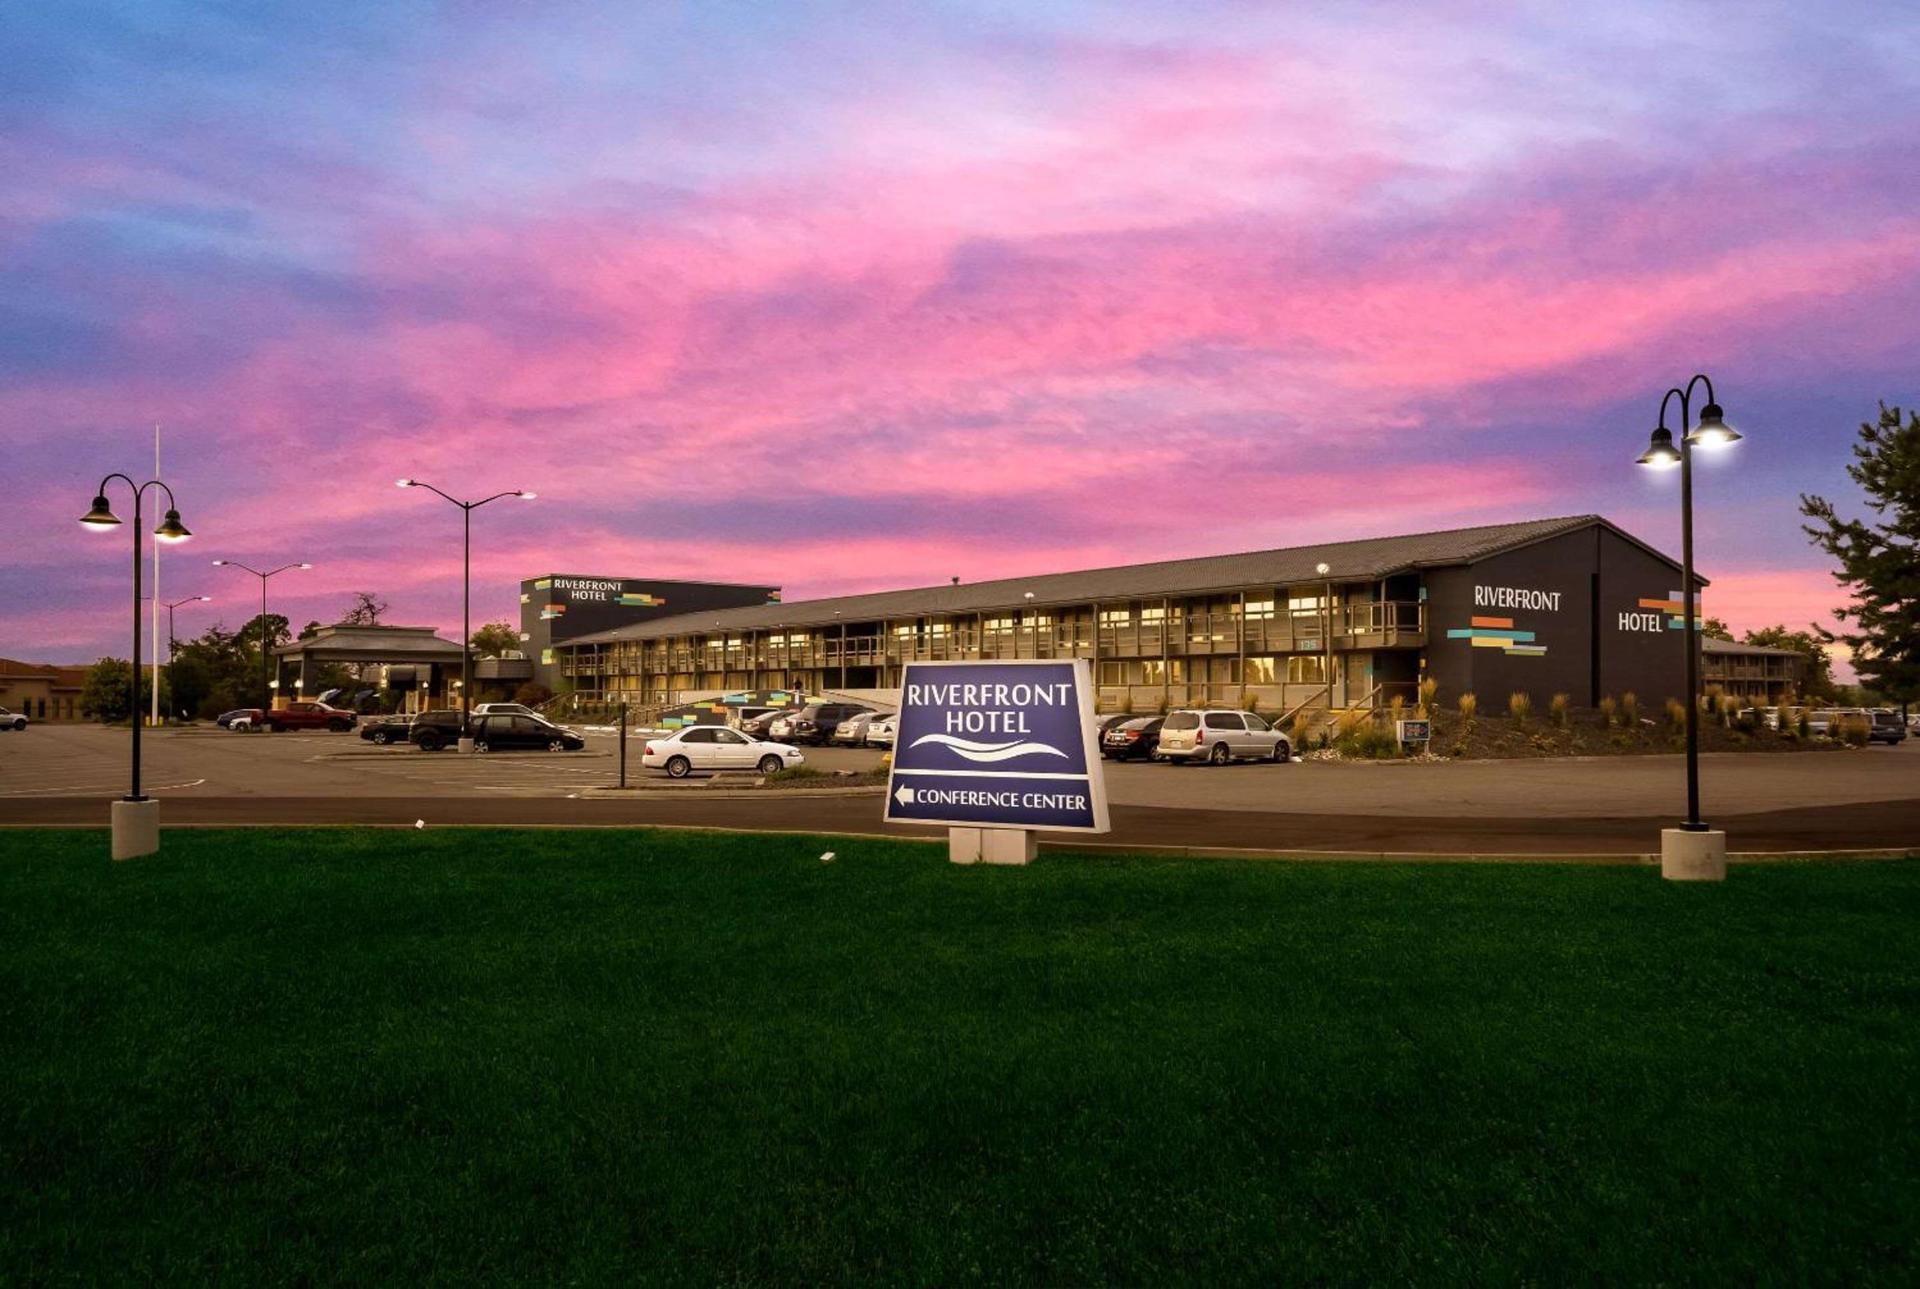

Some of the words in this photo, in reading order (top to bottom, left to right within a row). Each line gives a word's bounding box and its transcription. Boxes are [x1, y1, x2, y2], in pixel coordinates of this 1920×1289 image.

[554, 579, 621, 591] RIVERFRONT
[571, 590, 607, 601] HOTEL
[1475, 585, 1561, 611] RIVERFRONT
[1618, 612, 1663, 632] HOTEL
[908, 684, 1072, 706] RIVERFRONT
[946, 711, 1031, 733] HOTEL
[917, 789, 1019, 808] CONFERENCE
[1022, 792, 1087, 810] CENTER
